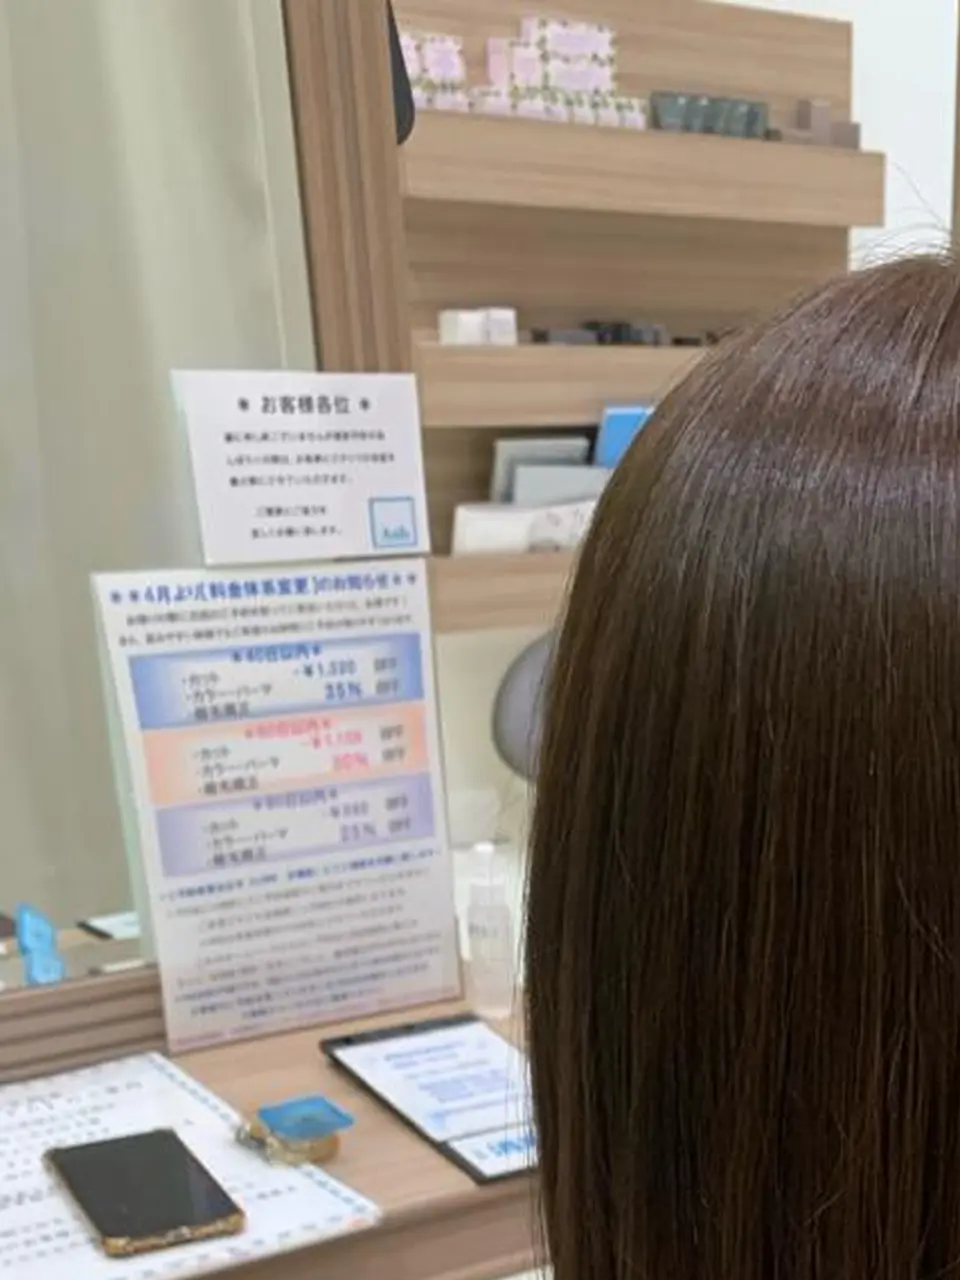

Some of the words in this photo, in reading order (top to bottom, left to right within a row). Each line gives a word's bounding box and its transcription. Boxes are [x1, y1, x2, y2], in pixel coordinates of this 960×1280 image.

[261, 395, 351, 415] お客様各位
